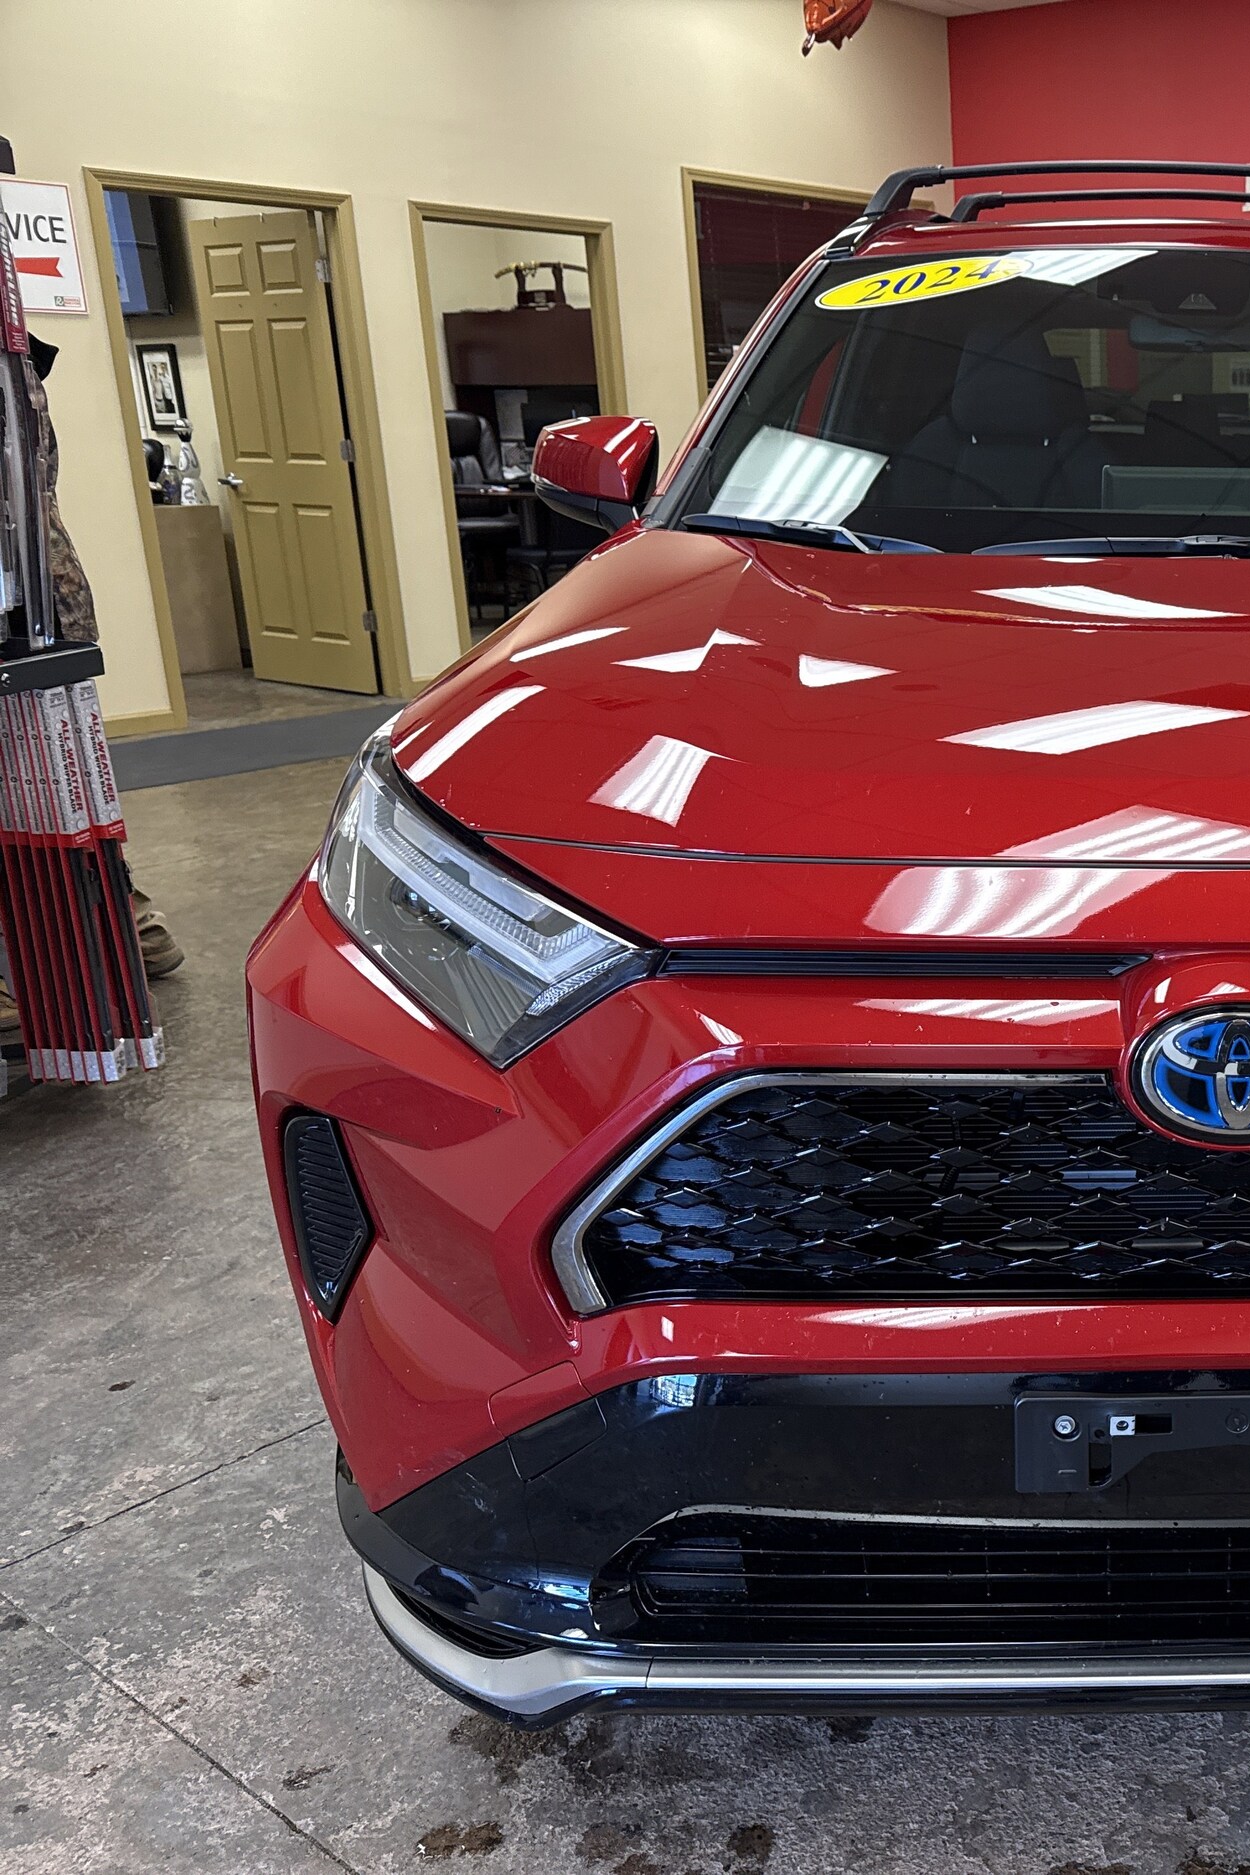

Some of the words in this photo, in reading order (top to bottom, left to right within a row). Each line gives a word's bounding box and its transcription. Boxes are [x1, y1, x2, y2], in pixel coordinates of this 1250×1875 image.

[854, 258, 1001, 304] 2024
[88, 725, 98, 756] HYBRID
[90, 712, 116, 803] ALL-WEATHER
[57, 732, 68, 762] HYBRID
[63, 762, 73, 786] WIPER
[68, 786, 78, 814] BLADE
[60, 719, 84, 812] ALL-WEATHER
[94, 755, 104, 778] WIPER
[98, 778, 109, 805] BLADE
